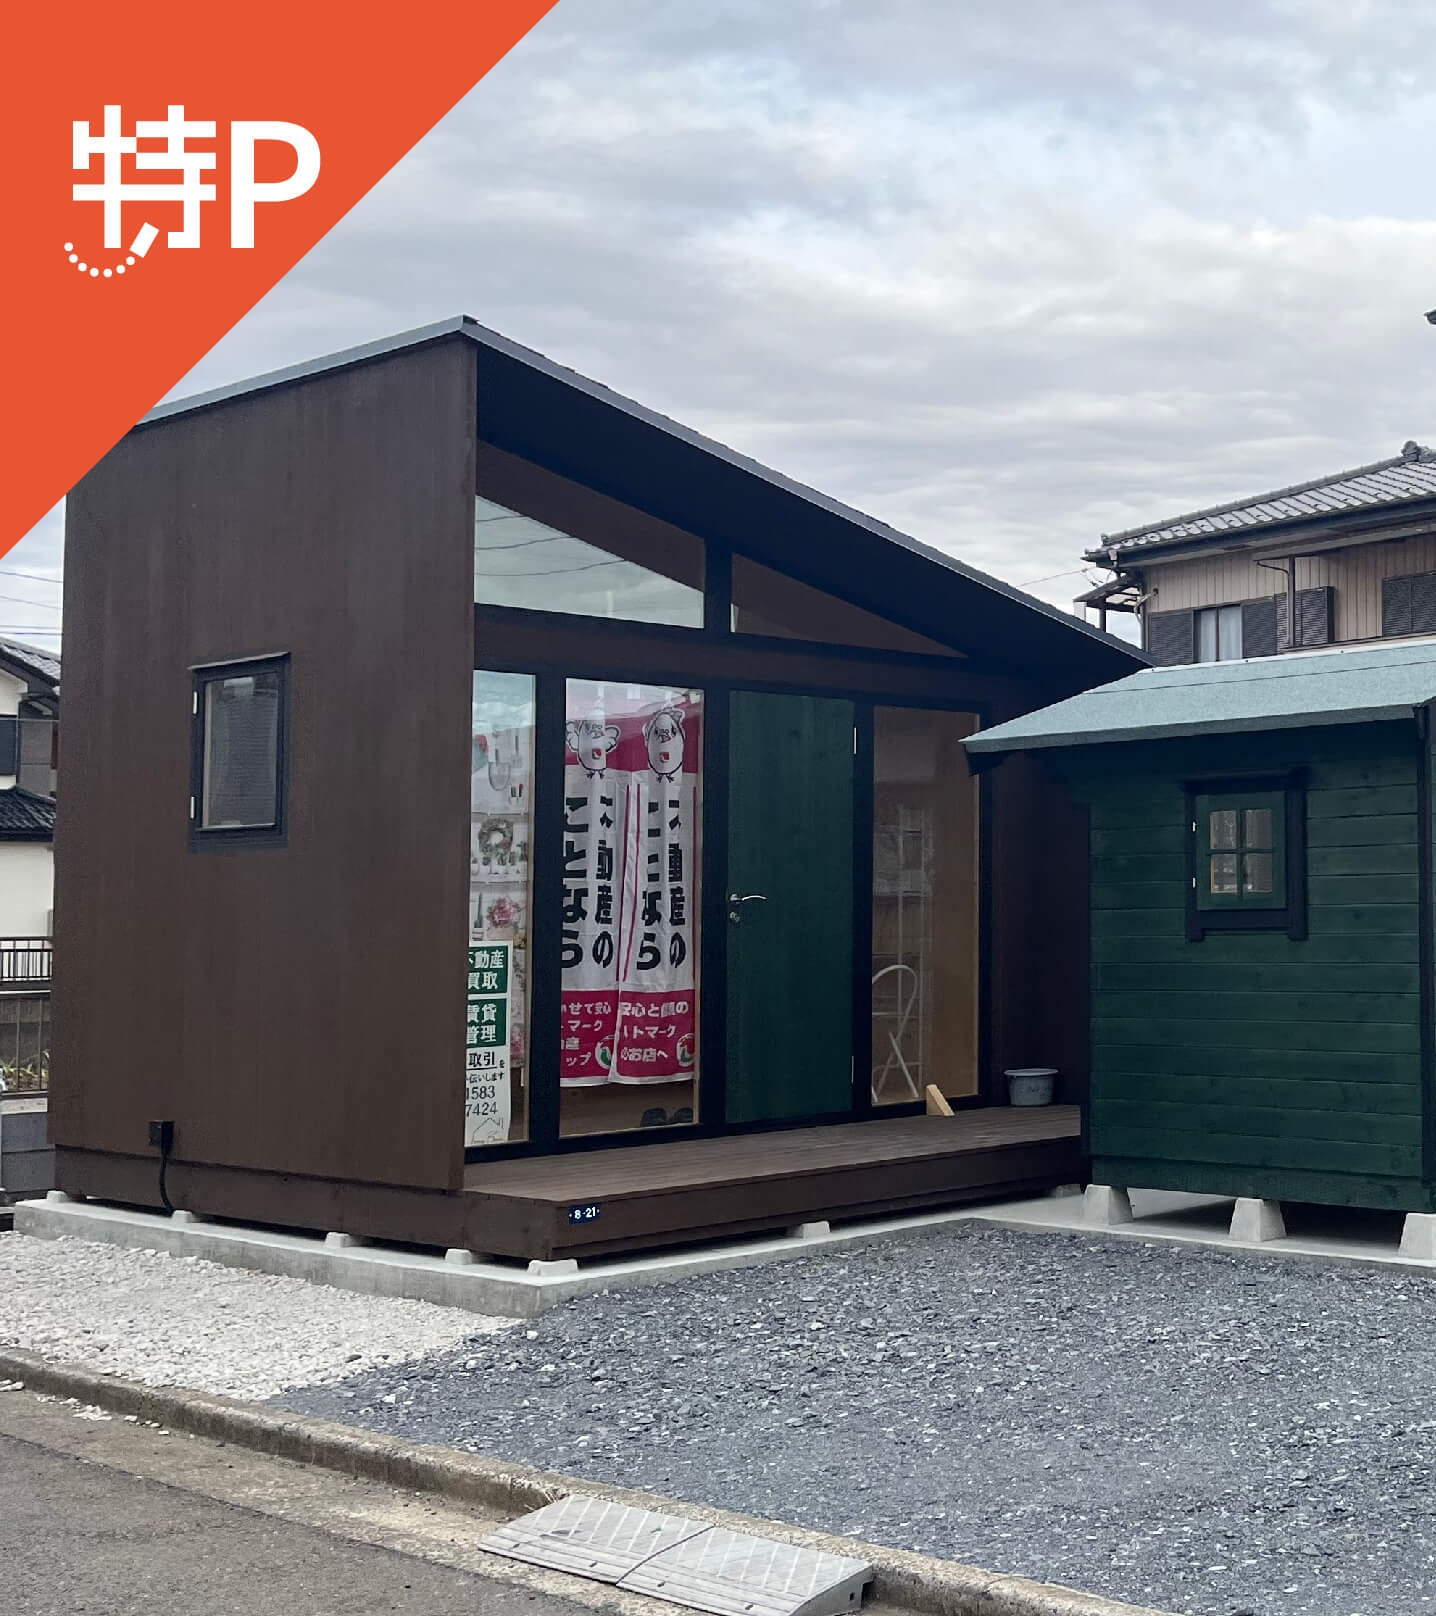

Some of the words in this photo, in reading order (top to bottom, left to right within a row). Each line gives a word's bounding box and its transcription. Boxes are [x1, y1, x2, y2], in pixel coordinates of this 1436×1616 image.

[561, 1020, 603, 1032] マーク
[466, 1071, 504, 1083] 伝いします
[574, 1206, 597, 1220] 8-21
